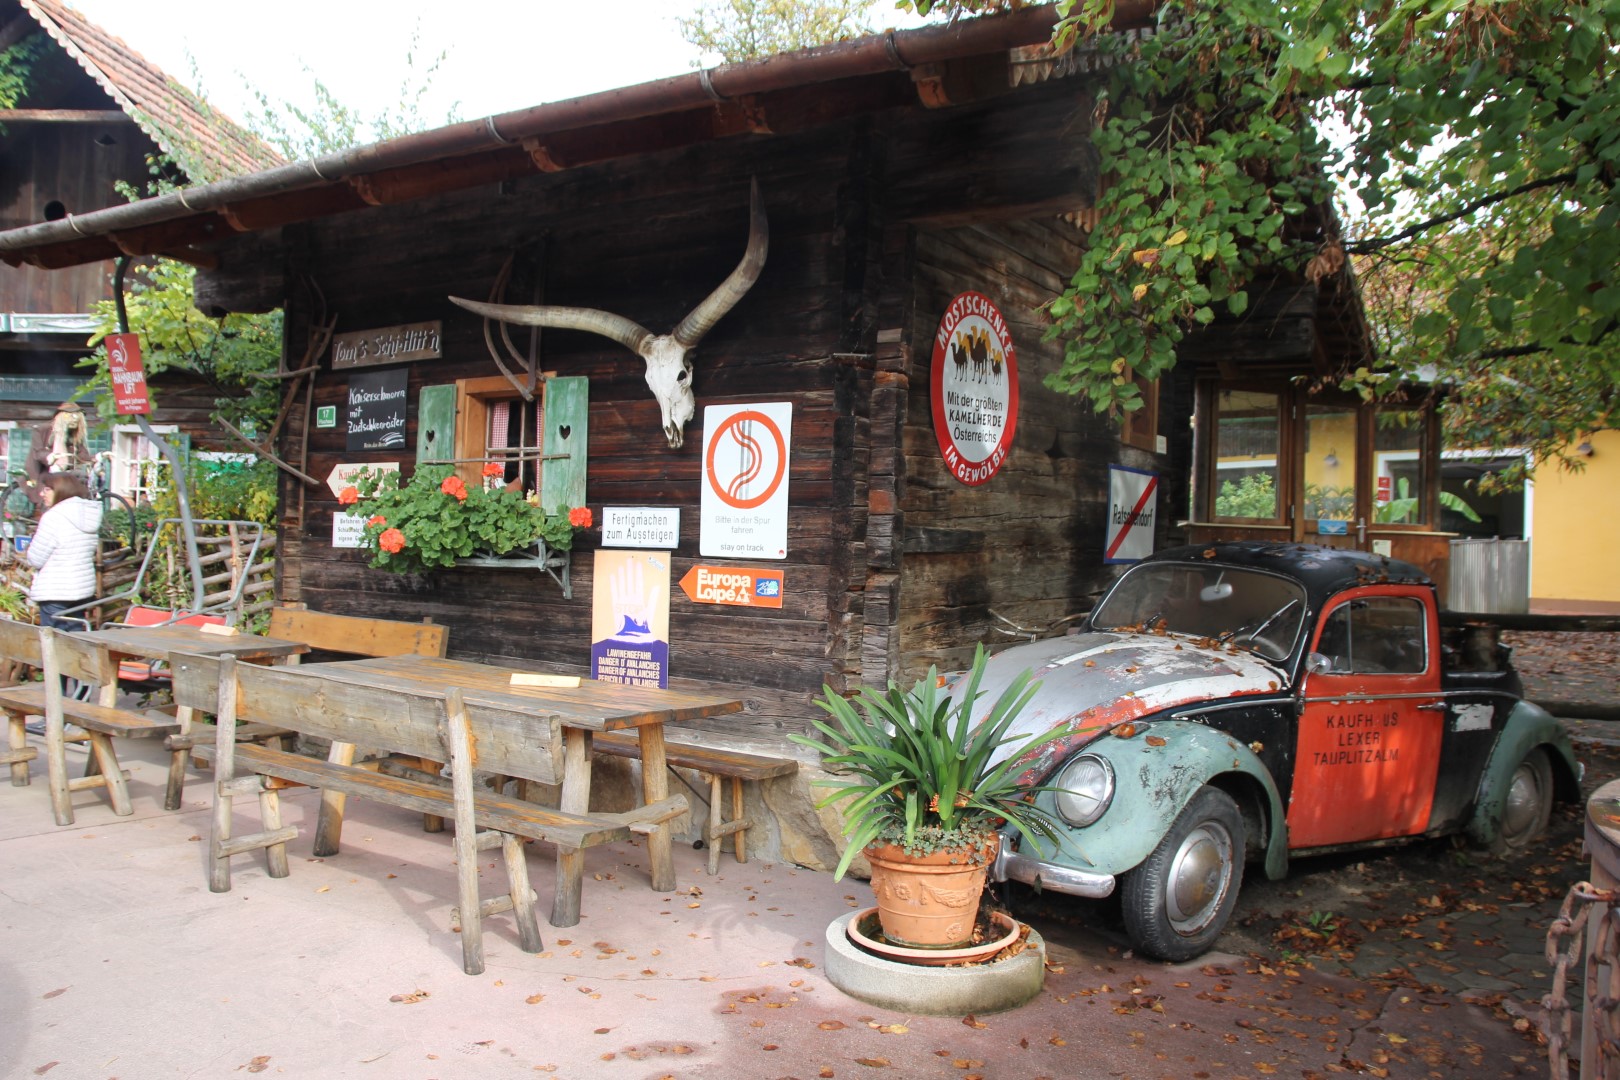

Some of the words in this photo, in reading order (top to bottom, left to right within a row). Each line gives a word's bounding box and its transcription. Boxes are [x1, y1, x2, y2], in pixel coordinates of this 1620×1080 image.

[938, 295, 1013, 358] MOSTSCHENKE
[947, 393, 960, 406] Mit
[960, 394, 974, 408] der
[975, 396, 1003, 412] größten
[322, 409, 330, 418] 17
[349, 406, 363, 418] mit
[949, 409, 1002, 427] KAMELHERDE
[953, 424, 997, 443] Österreichs
[945, 444, 958, 469] IM
[957, 443, 1005, 482] GEWÖLBE
[612, 513, 668, 528] Fertigmachen
[715, 515, 732, 524] Bitte
[733, 516, 740, 524] in
[741, 516, 752, 525] der
[753, 516, 771, 526] Spur
[606, 530, 623, 540] zum
[626, 528, 674, 543] Aussteigen
[731, 525, 754, 534] fahren
[720, 544, 735, 553] stay
[746, 544, 765, 552] track
[698, 569, 751, 589] Europa
[697, 583, 736, 603] Loipe
[607, 649, 652, 660] LAWINENGEFAHR
[598, 656, 619, 667] DANGER
[626, 659, 660, 671] AVALANCHES
[598, 665, 619, 675] DANGER
[619, 667, 626, 676] OF
[626, 667, 660, 680] AVALANCHES
[1339, 732, 1380, 746] LEXER
[1314, 749, 1399, 765] TAUPLITZALM
